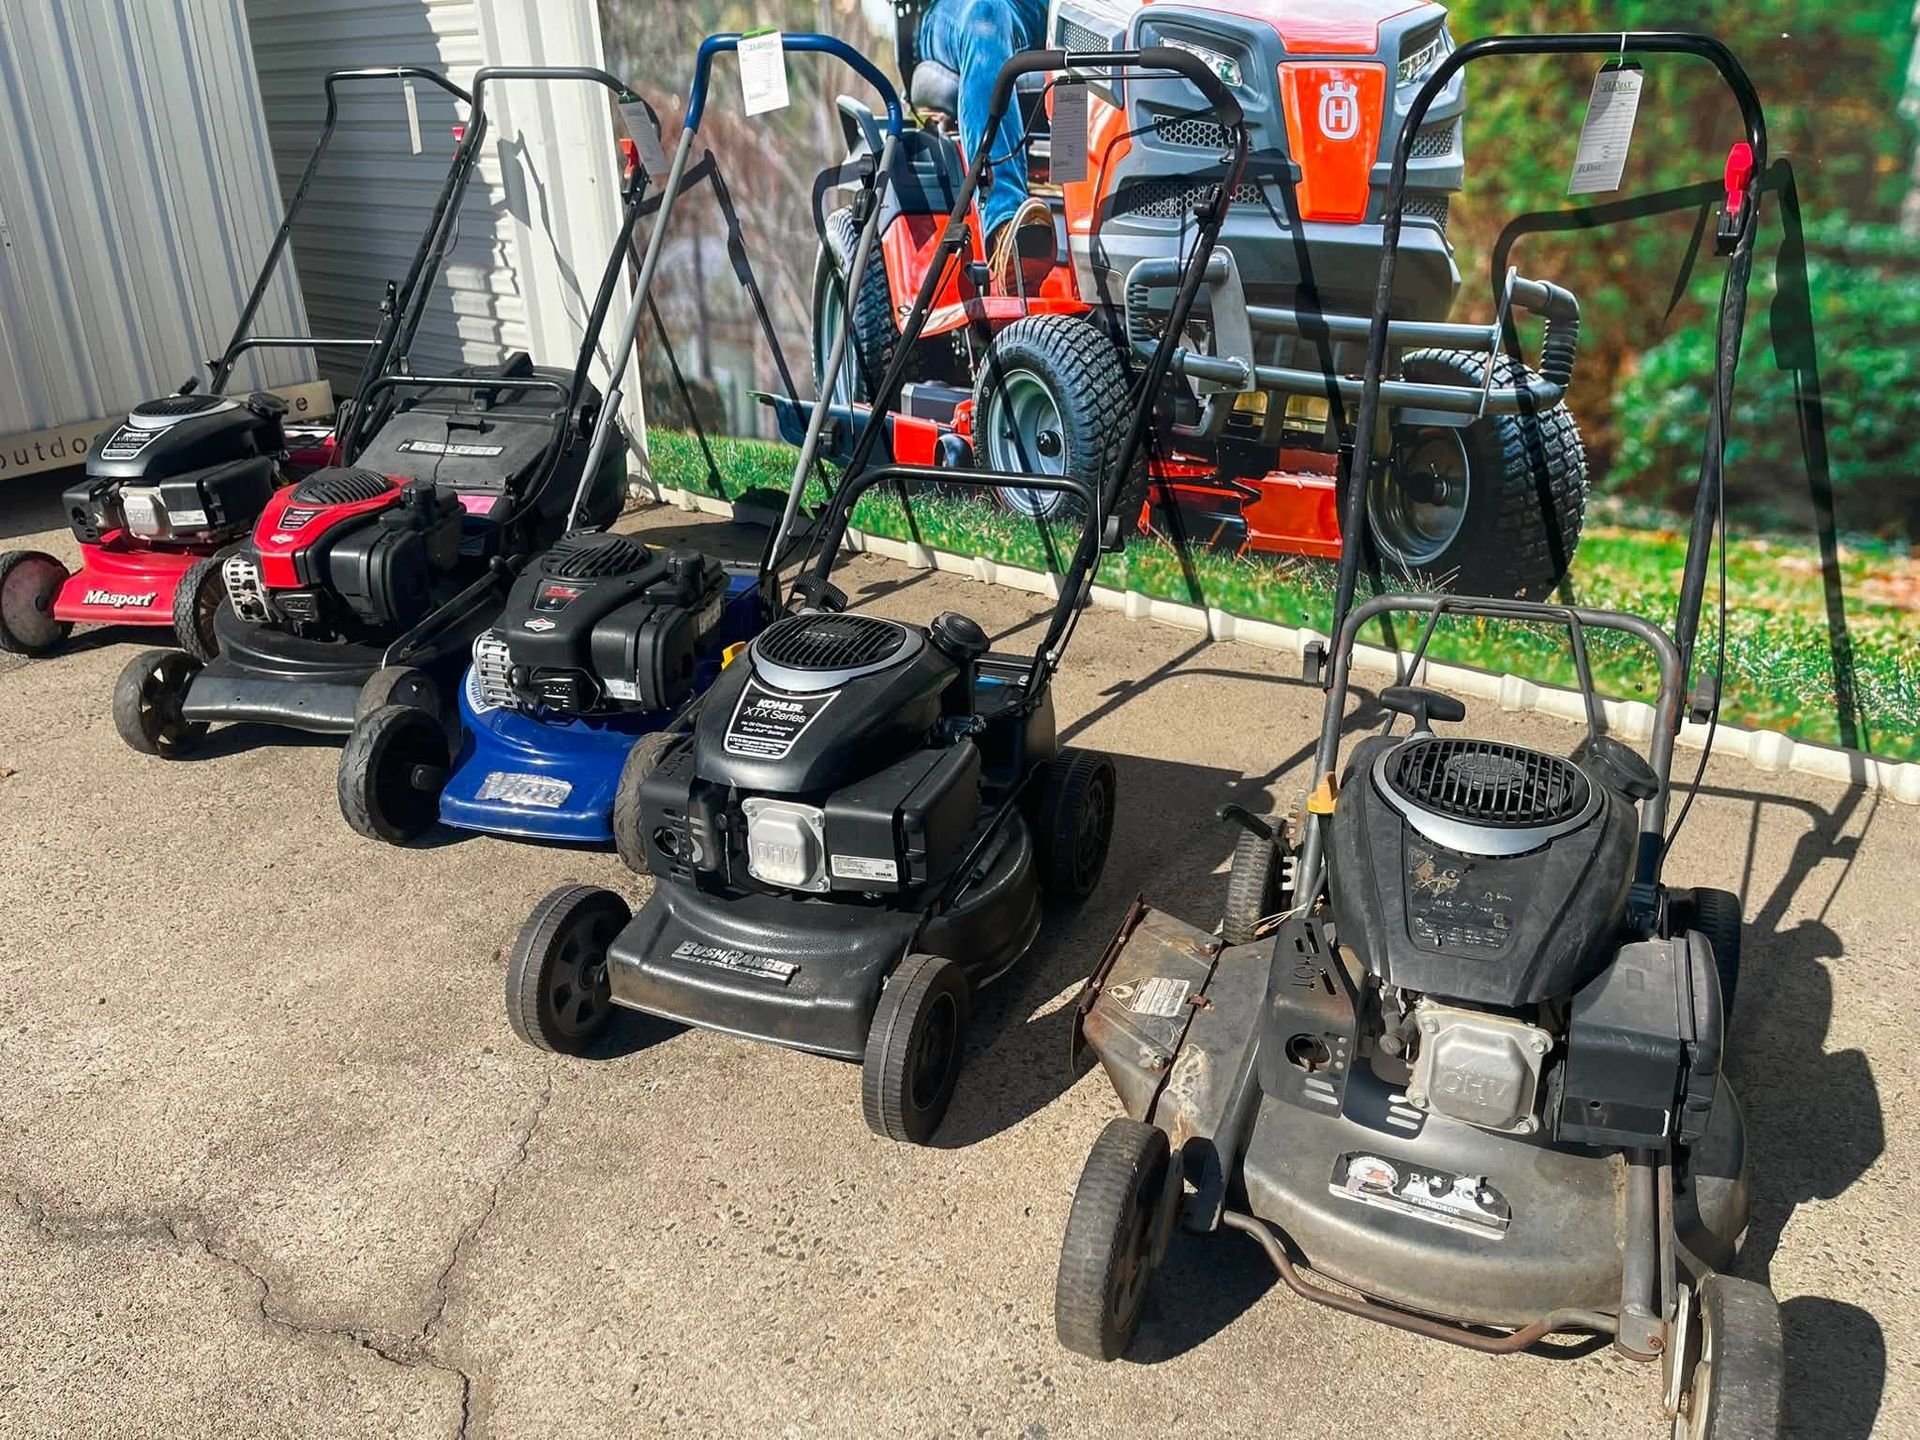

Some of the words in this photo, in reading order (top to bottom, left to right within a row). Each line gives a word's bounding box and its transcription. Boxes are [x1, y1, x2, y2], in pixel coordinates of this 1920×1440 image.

[83, 590, 155, 608] Masport
[743, 707, 771, 718] XTX
[770, 710, 807, 723] Series
[755, 842, 798, 865] OHV
[674, 940, 800, 975] BUSHRANGER
[1440, 1069, 1513, 1105] OHV
